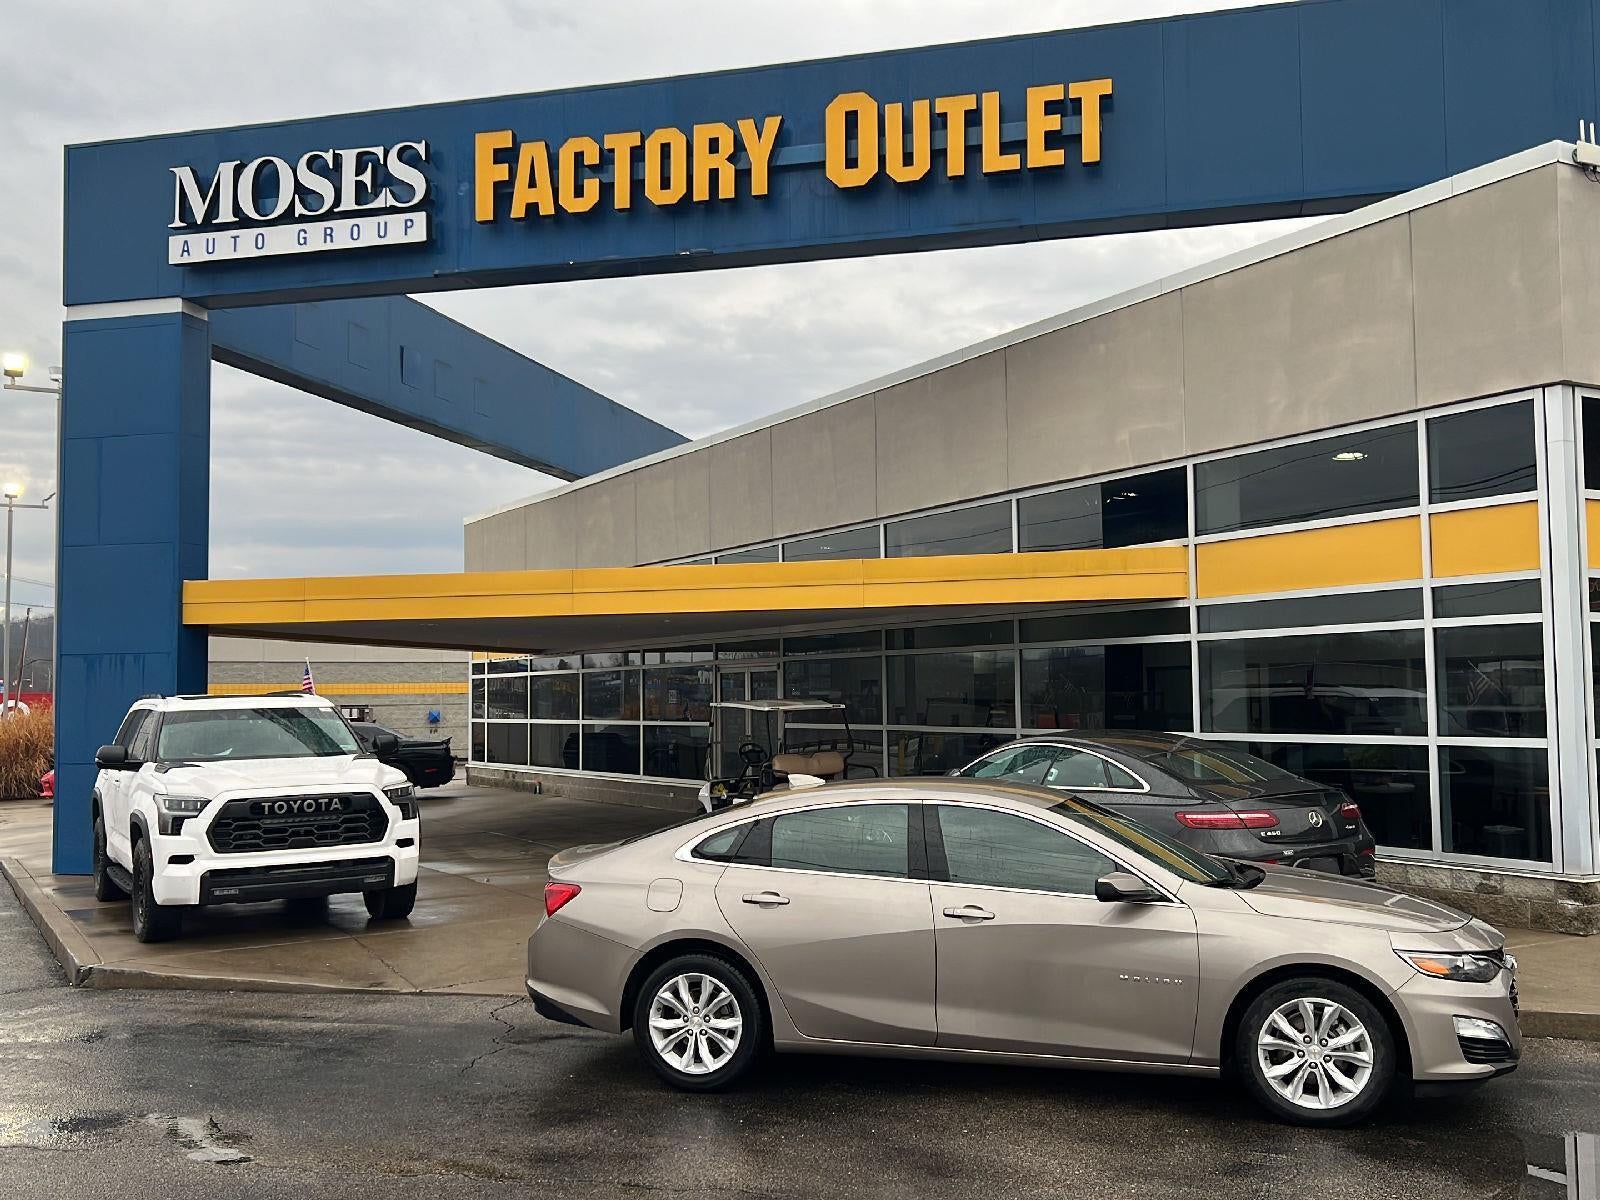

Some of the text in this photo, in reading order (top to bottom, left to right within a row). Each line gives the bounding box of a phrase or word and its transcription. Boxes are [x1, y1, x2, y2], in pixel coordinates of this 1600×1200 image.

[474, 78, 1114, 222] FACTORY OUTLET
[168, 139, 429, 229] MOSES
[180, 218, 416, 258] AUTO GROUP
[260, 798, 343, 816] TOYOTA
